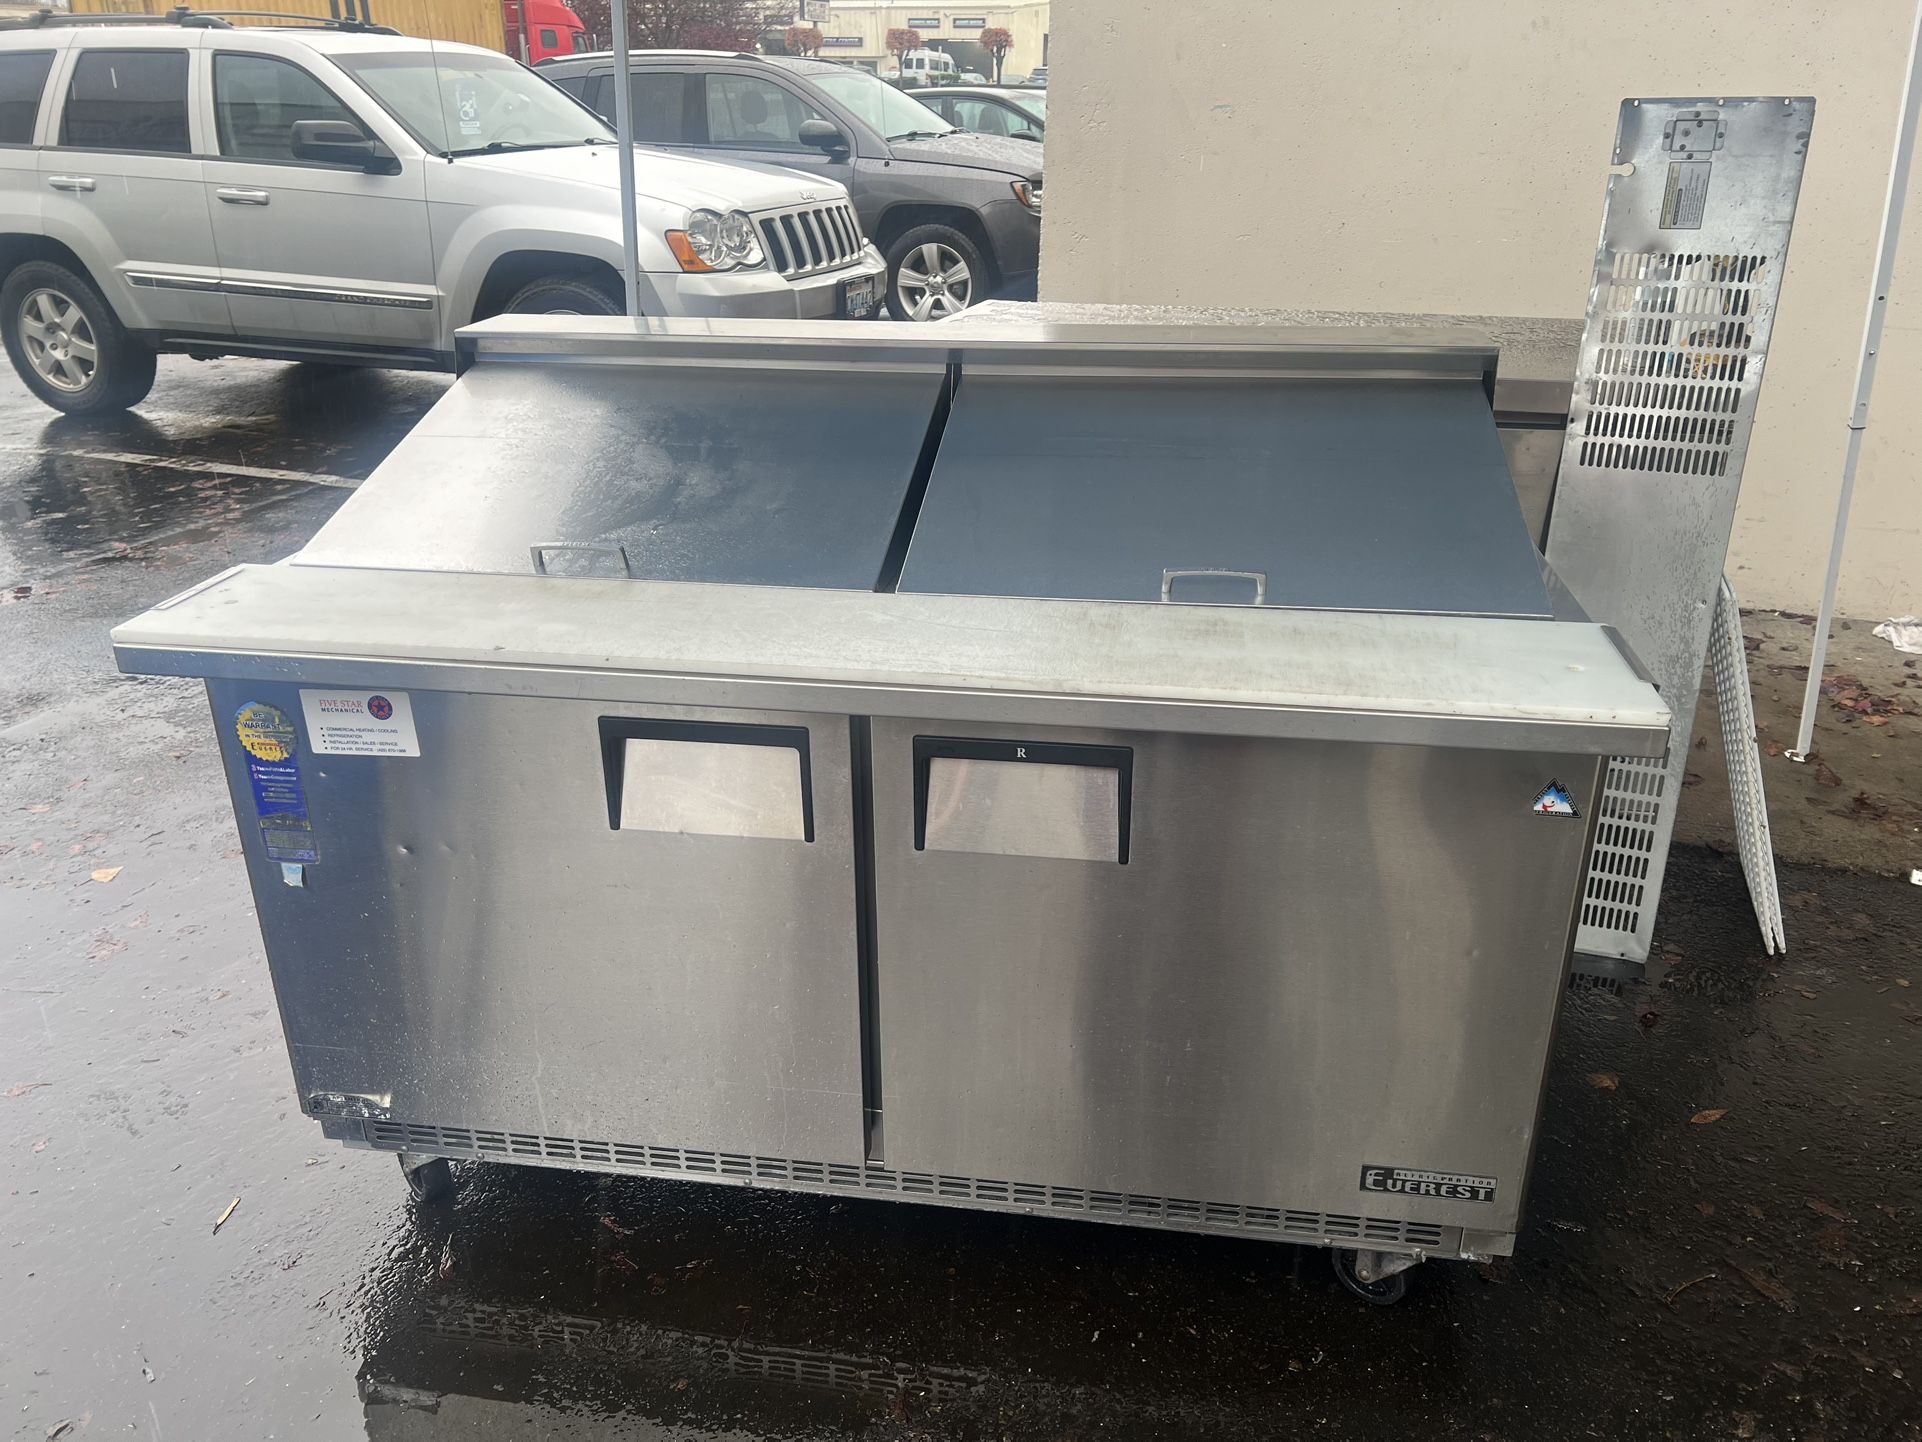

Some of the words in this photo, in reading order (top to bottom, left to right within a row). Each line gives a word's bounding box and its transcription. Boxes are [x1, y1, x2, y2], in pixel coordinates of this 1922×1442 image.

[339, 700, 363, 708] STAR
[1016, 747, 1027, 758] R
[1365, 1169, 1492, 1200] EVEREST
